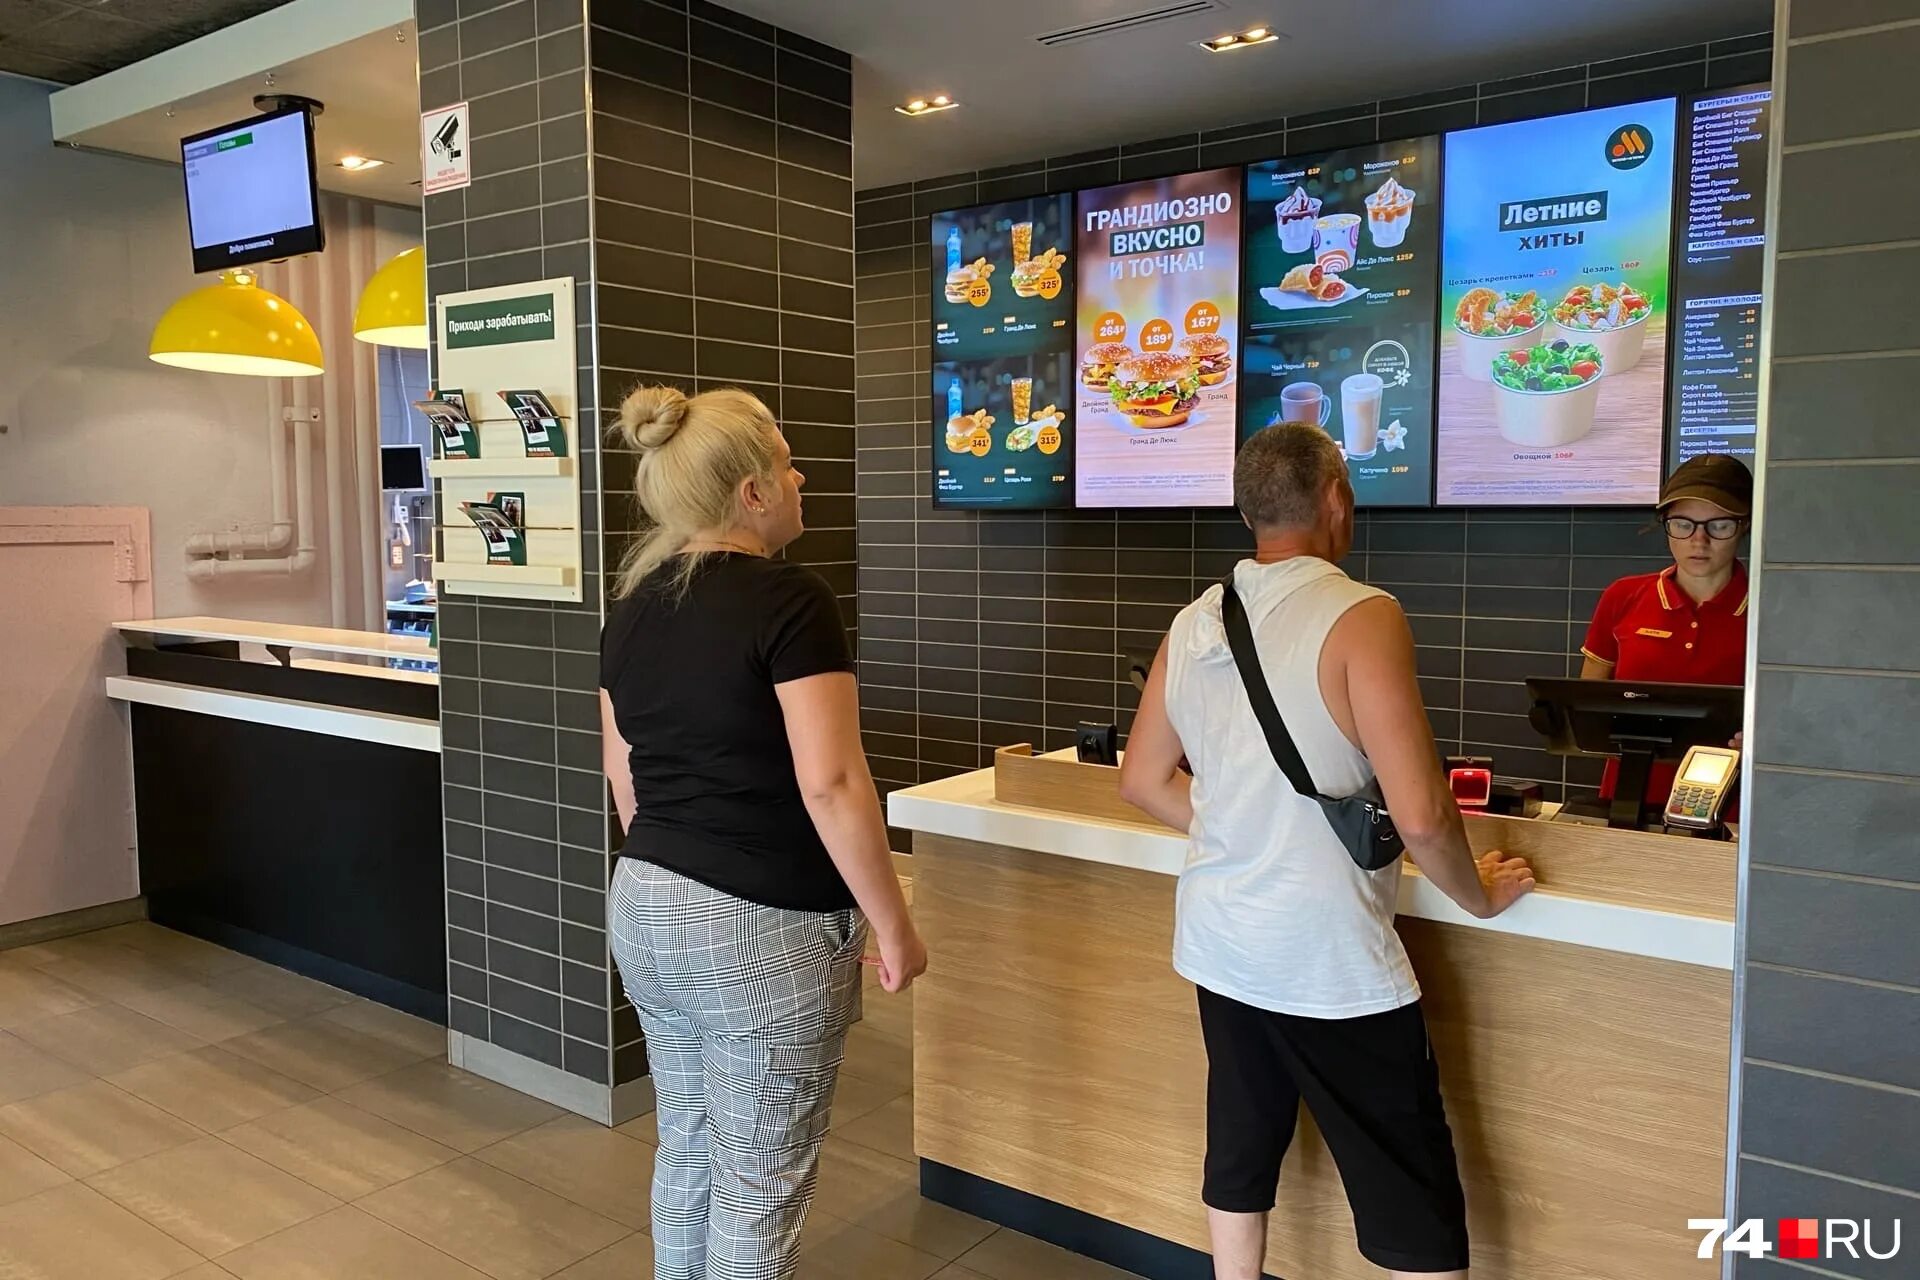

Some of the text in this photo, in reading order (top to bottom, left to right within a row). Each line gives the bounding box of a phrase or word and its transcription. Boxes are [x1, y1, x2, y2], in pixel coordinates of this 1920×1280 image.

[1086, 192, 1232, 232] ГРАНДИОЗНО
[1504, 199, 1601, 226] Летние
[1113, 224, 1201, 254] ВКУСНО
[1109, 251, 1204, 281] И ТОЧКА!
[1583, 266, 1614, 274] Цезарь
[1448, 277, 1477, 286] Цезарь
[1486, 273, 1534, 282] креветками
[449, 309, 552, 334] Приходи зарабатывать!
[1513, 453, 1552, 461] Овощной
